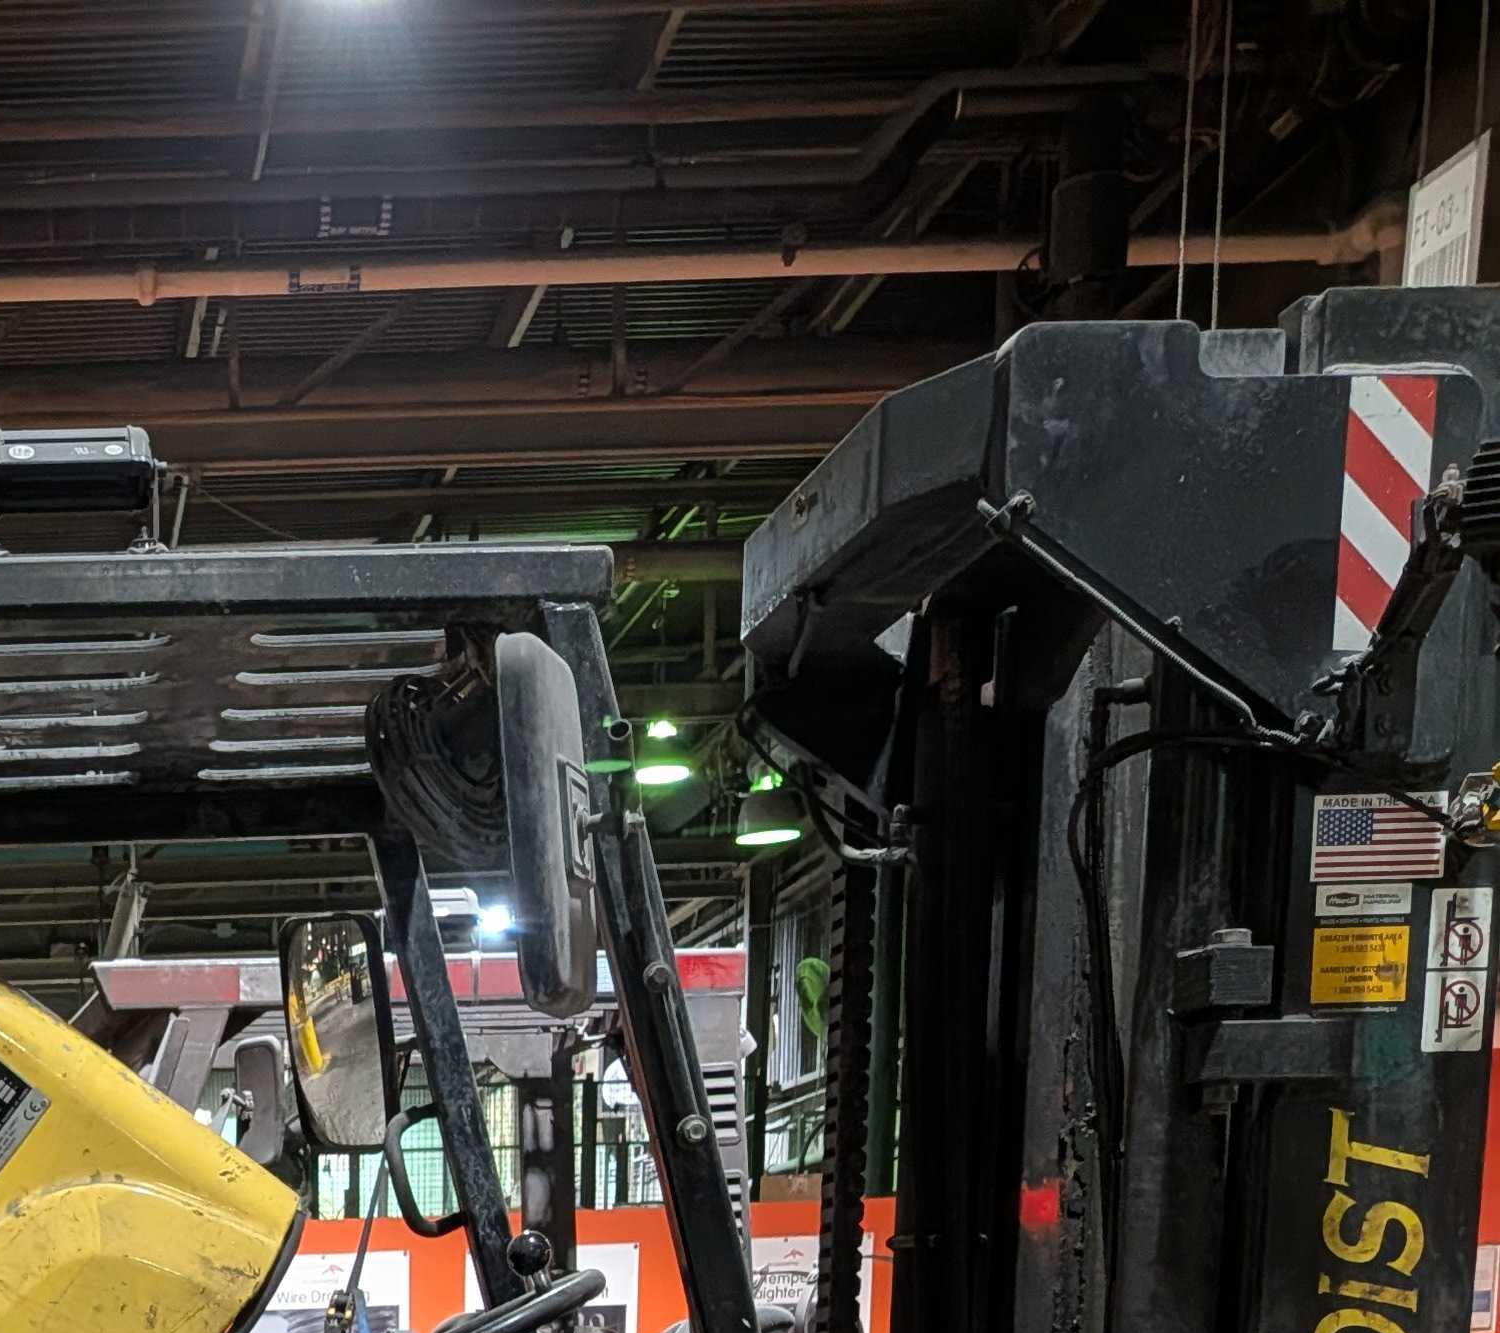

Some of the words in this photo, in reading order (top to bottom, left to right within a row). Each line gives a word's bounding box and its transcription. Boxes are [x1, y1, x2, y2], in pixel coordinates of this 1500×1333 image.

[1322, 798, 1358, 808] MADE
[1360, 797, 1373, 807] IN
[276, 1290, 307, 1304] Wire
